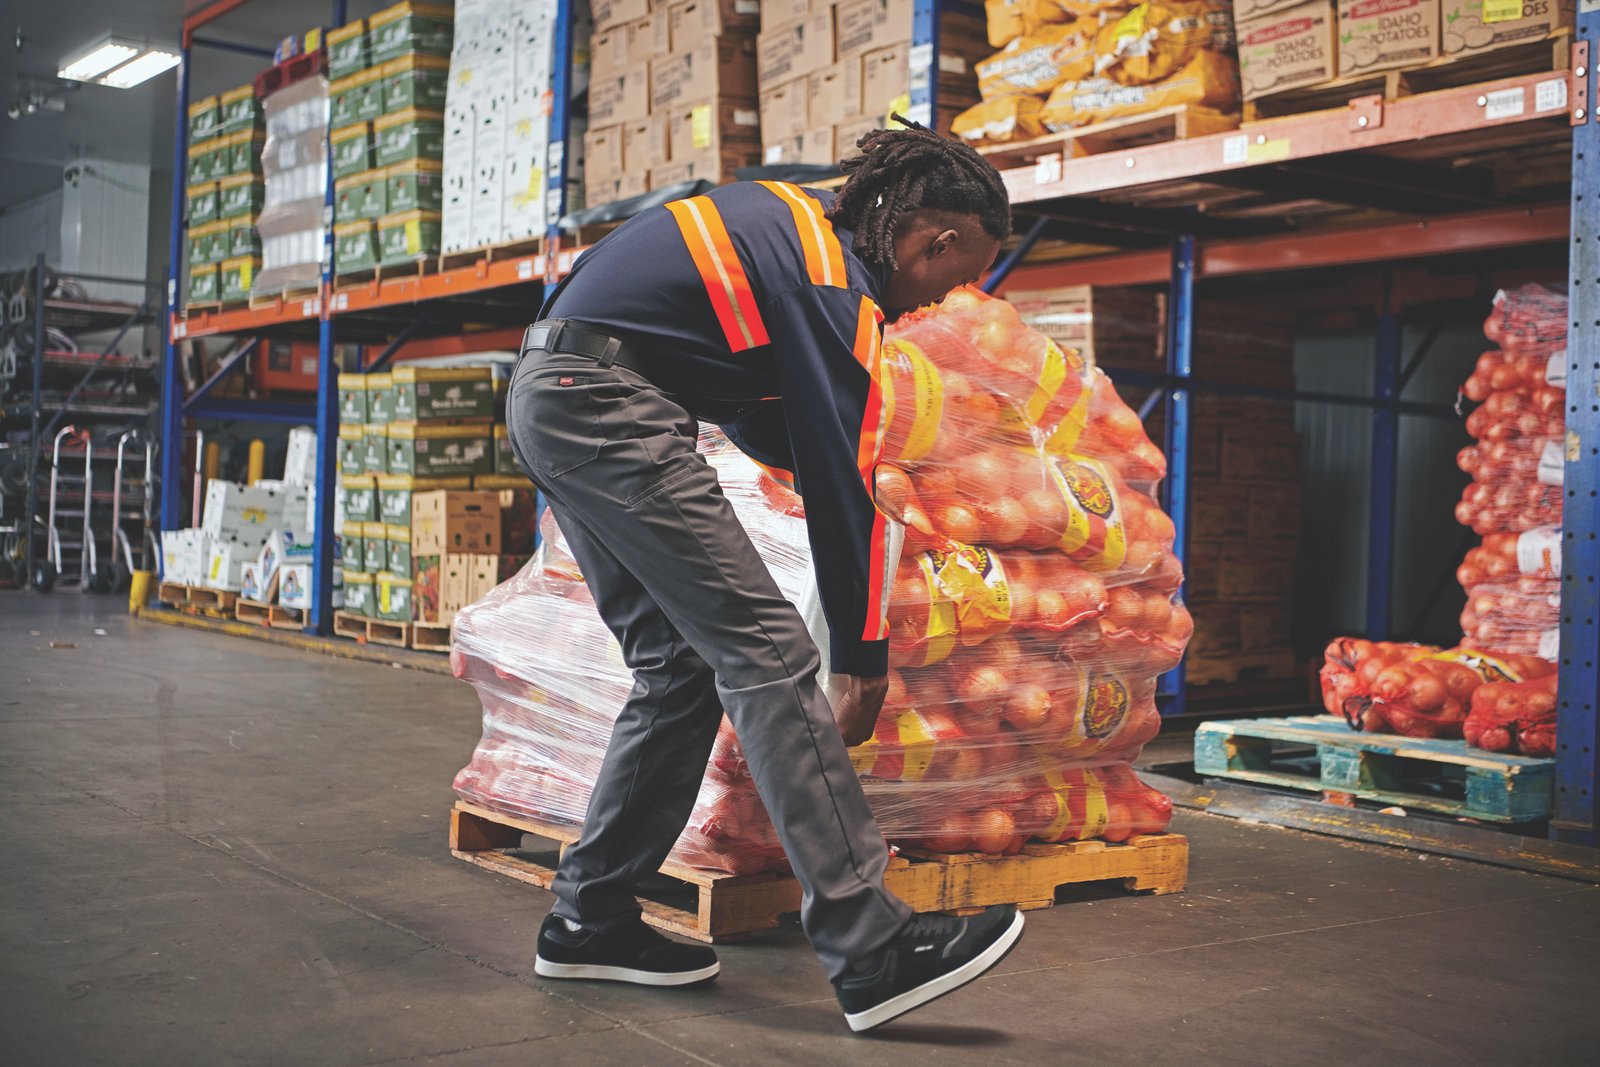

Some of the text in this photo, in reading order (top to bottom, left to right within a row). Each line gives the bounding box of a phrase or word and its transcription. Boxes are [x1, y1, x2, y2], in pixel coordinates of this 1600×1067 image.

[1378, 12, 1421, 30] IDAHO
[1274, 35, 1316, 51] IDAHO
[1369, 25, 1430, 45] POTATOES
[1266, 48, 1324, 69] POTATOES
